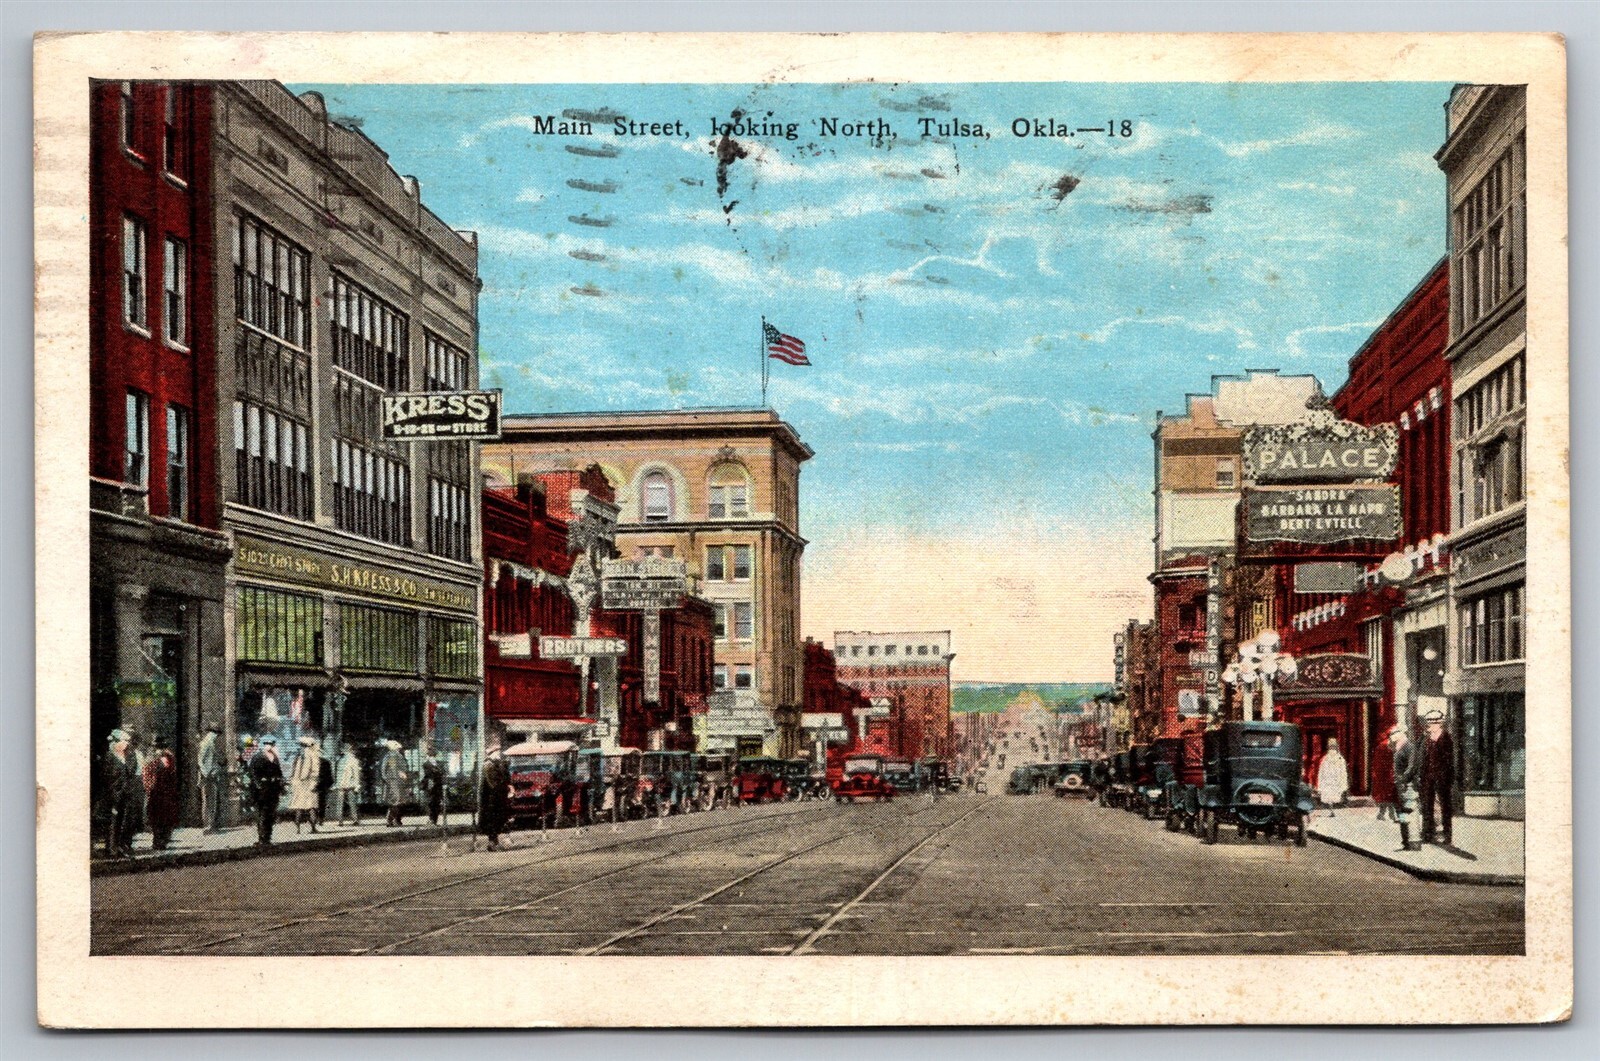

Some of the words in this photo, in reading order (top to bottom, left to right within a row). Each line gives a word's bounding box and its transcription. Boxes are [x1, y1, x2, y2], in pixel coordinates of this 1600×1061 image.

[1260, 449, 1380, 469] PALACE
[1327, 504, 1344, 515] LA
[1280, 518, 1312, 530] BERT
[544, 638, 627, 653] BROTHERS
